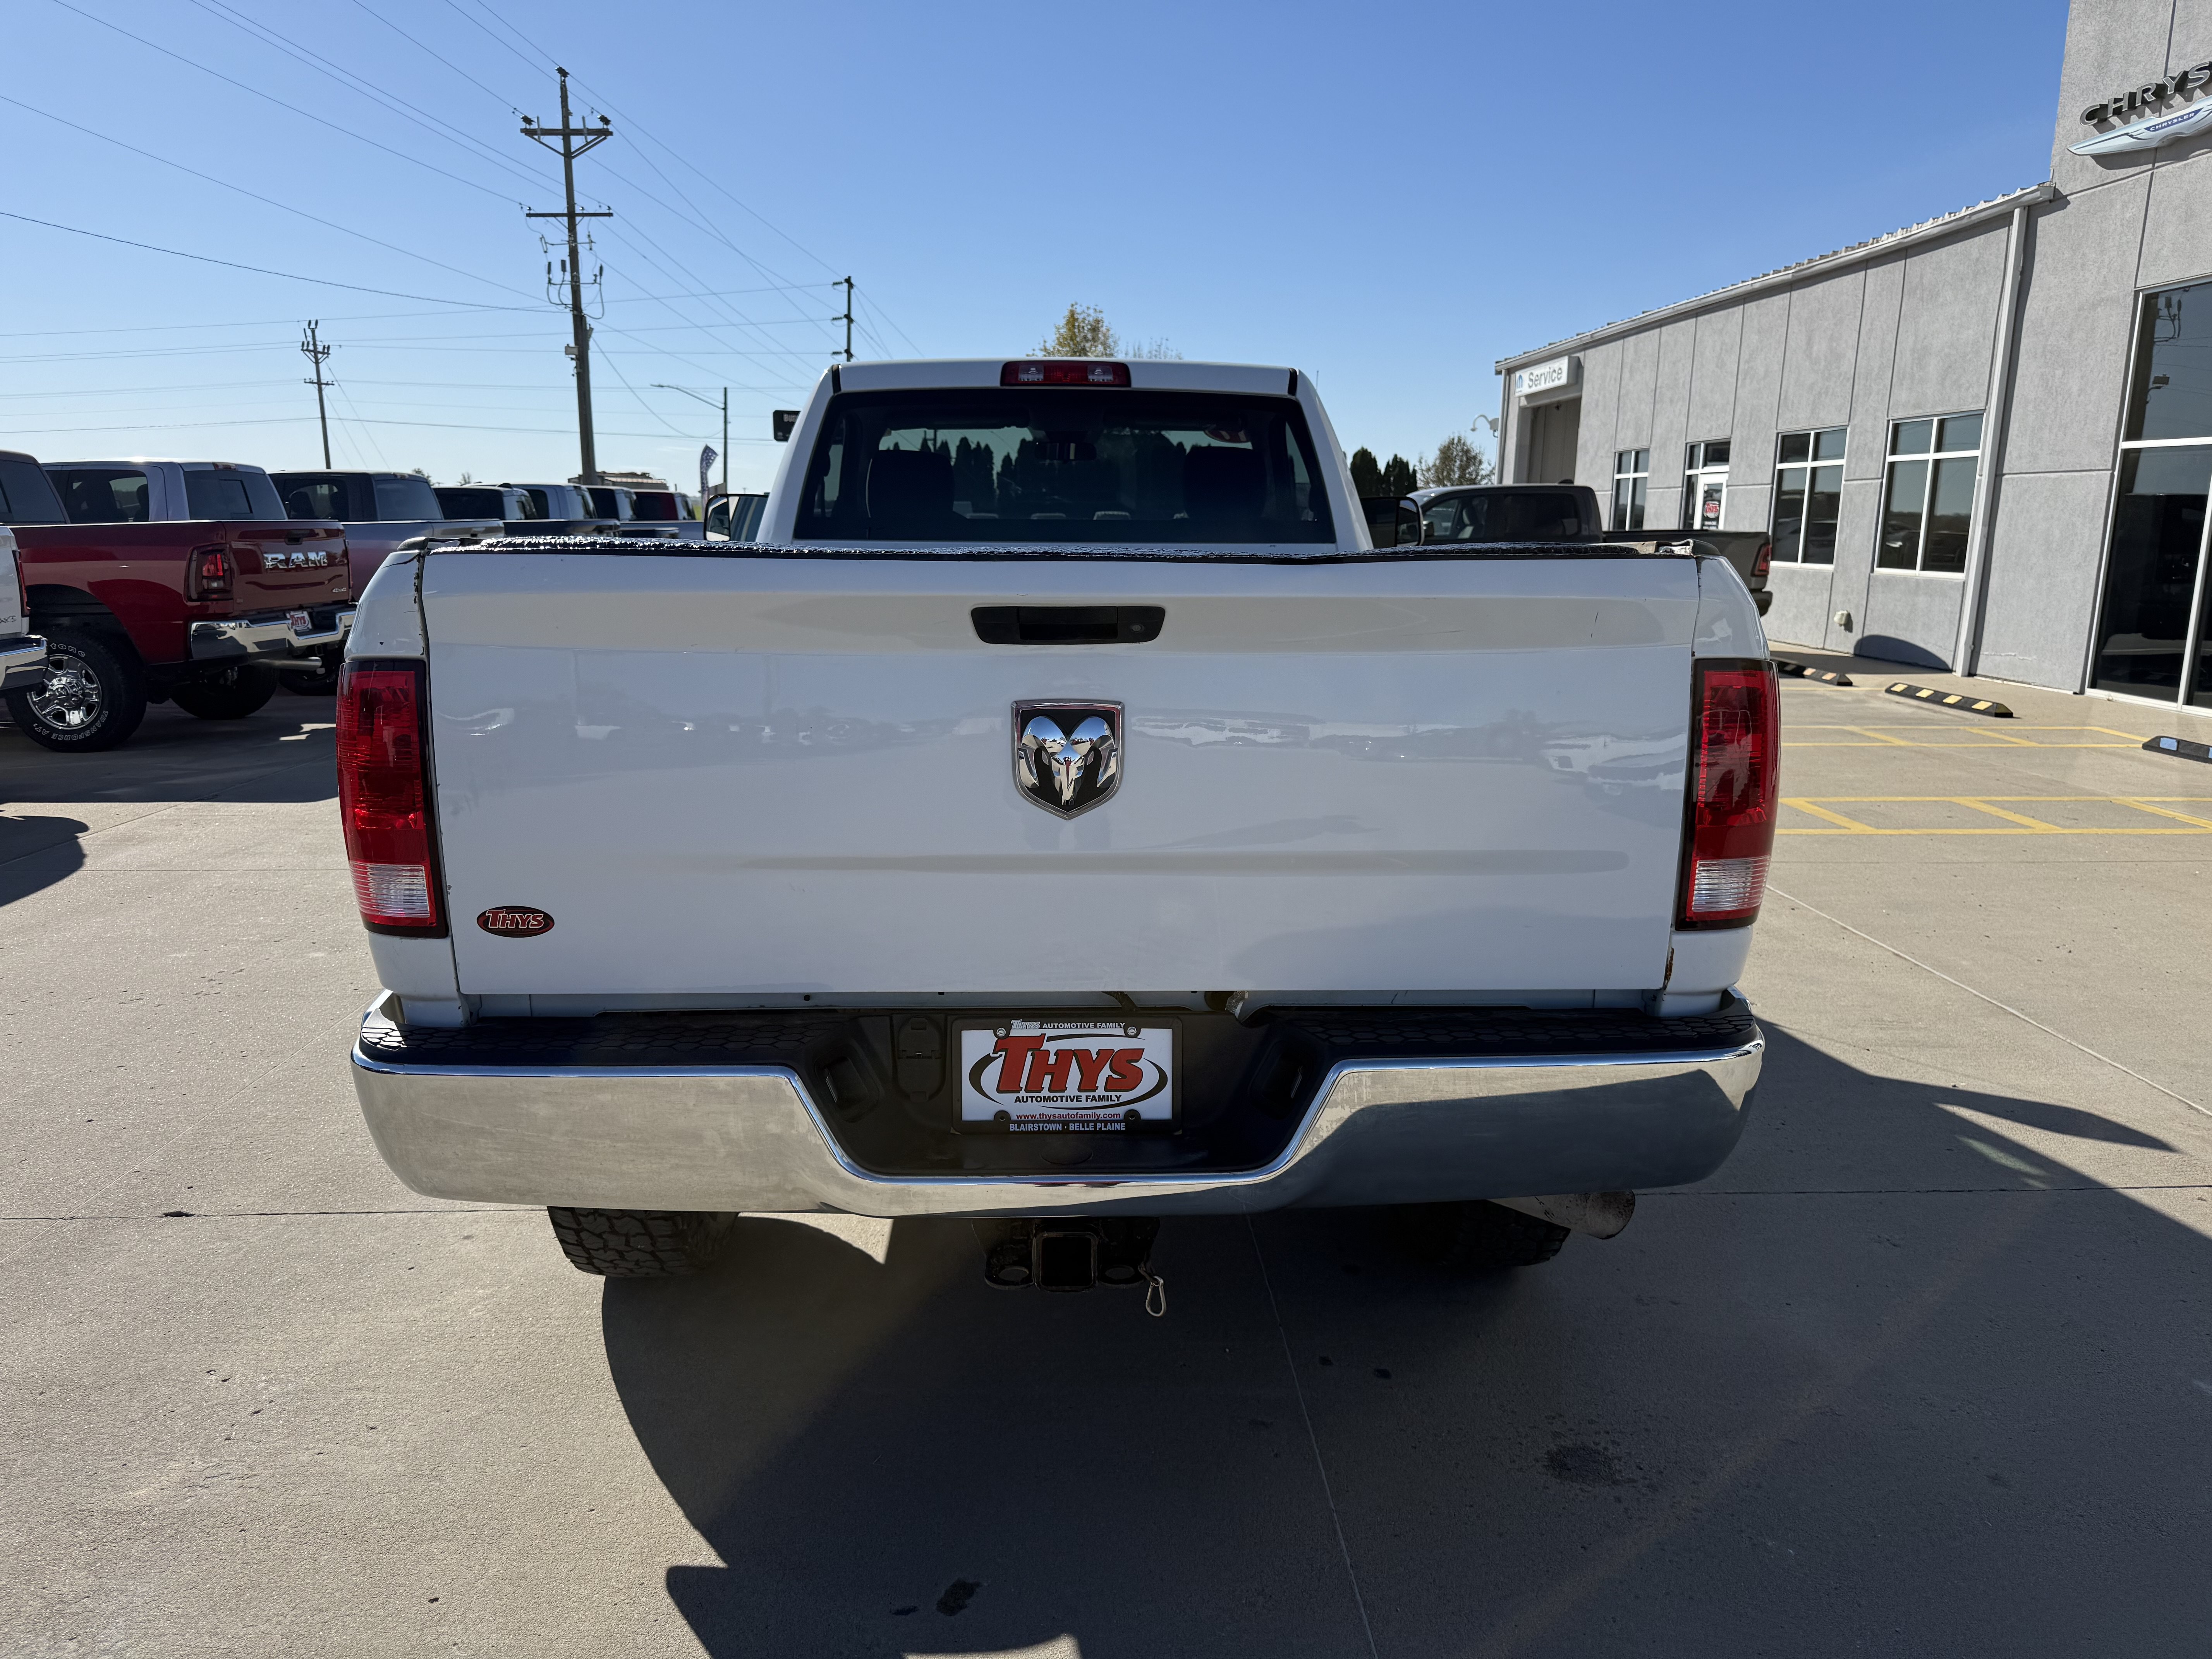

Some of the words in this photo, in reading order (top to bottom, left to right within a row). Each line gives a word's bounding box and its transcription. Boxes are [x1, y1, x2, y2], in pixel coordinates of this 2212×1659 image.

[2150, 112, 2195, 131] CHRYSLER
[1528, 366, 1562, 388] Service
[263, 551, 328, 569] RAM
[51, 710, 109, 741] TRANSFORCE
[992, 1033, 1145, 1094] THYS
